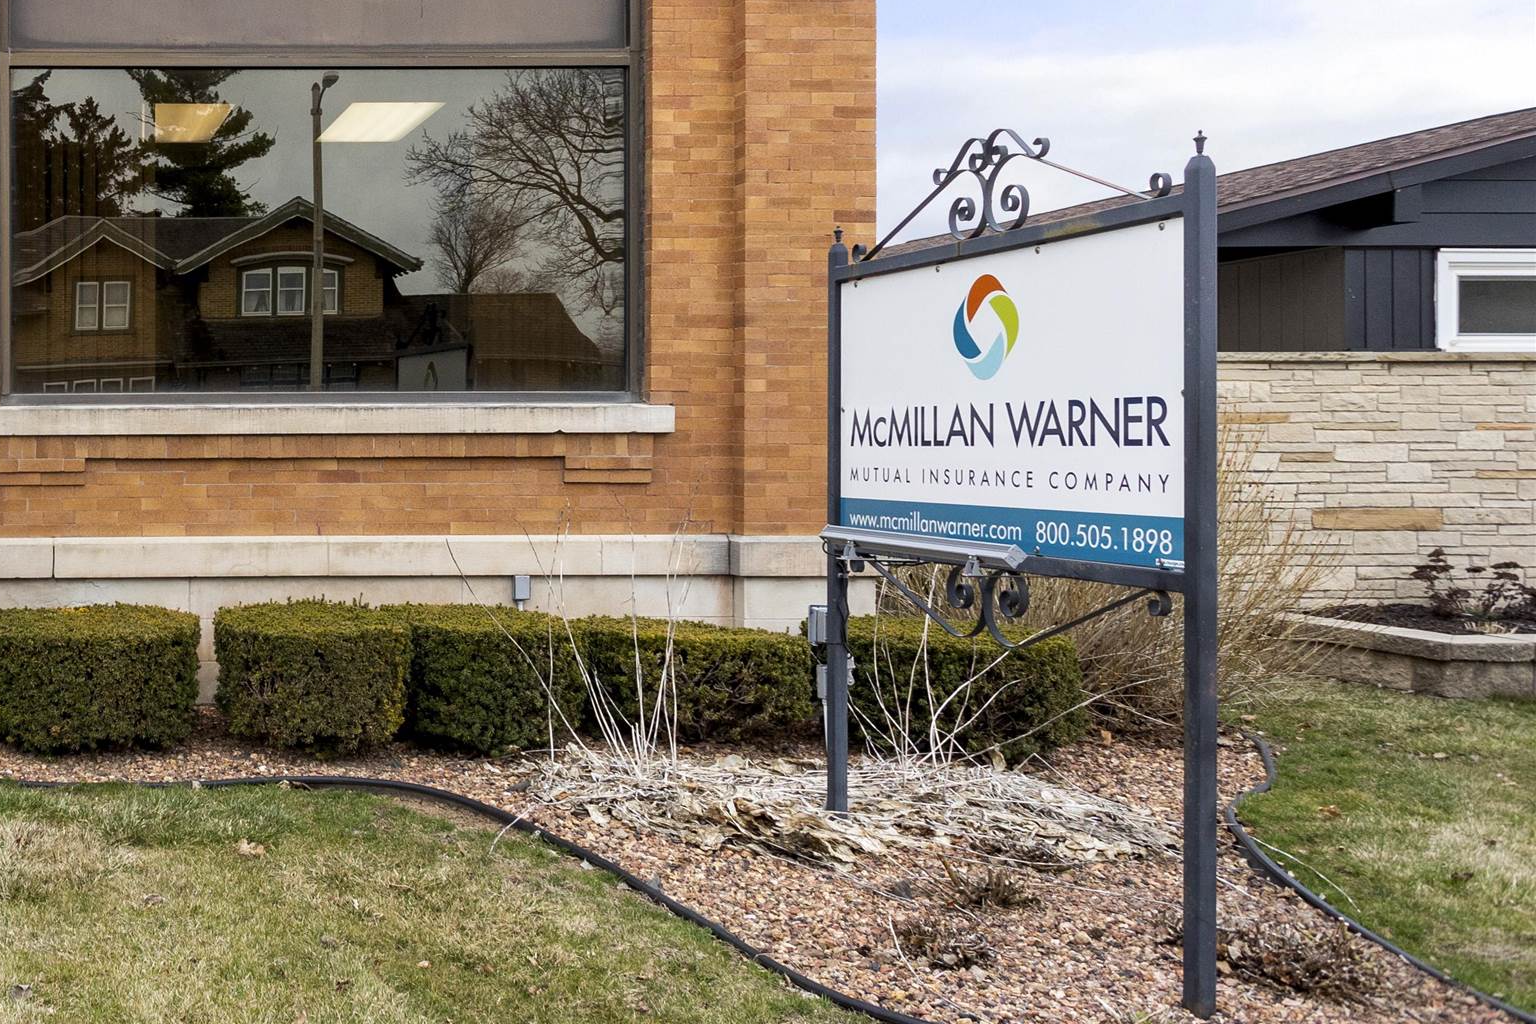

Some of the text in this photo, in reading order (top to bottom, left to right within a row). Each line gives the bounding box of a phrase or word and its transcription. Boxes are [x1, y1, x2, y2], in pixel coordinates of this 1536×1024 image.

[850, 396, 1171, 448] McMILLAN WARNER
[850, 467, 1170, 494] MUTUAL INSURANCE COMPANY
[849, 511, 1173, 555] www.mcmillanwarner.com 800.505.1898
